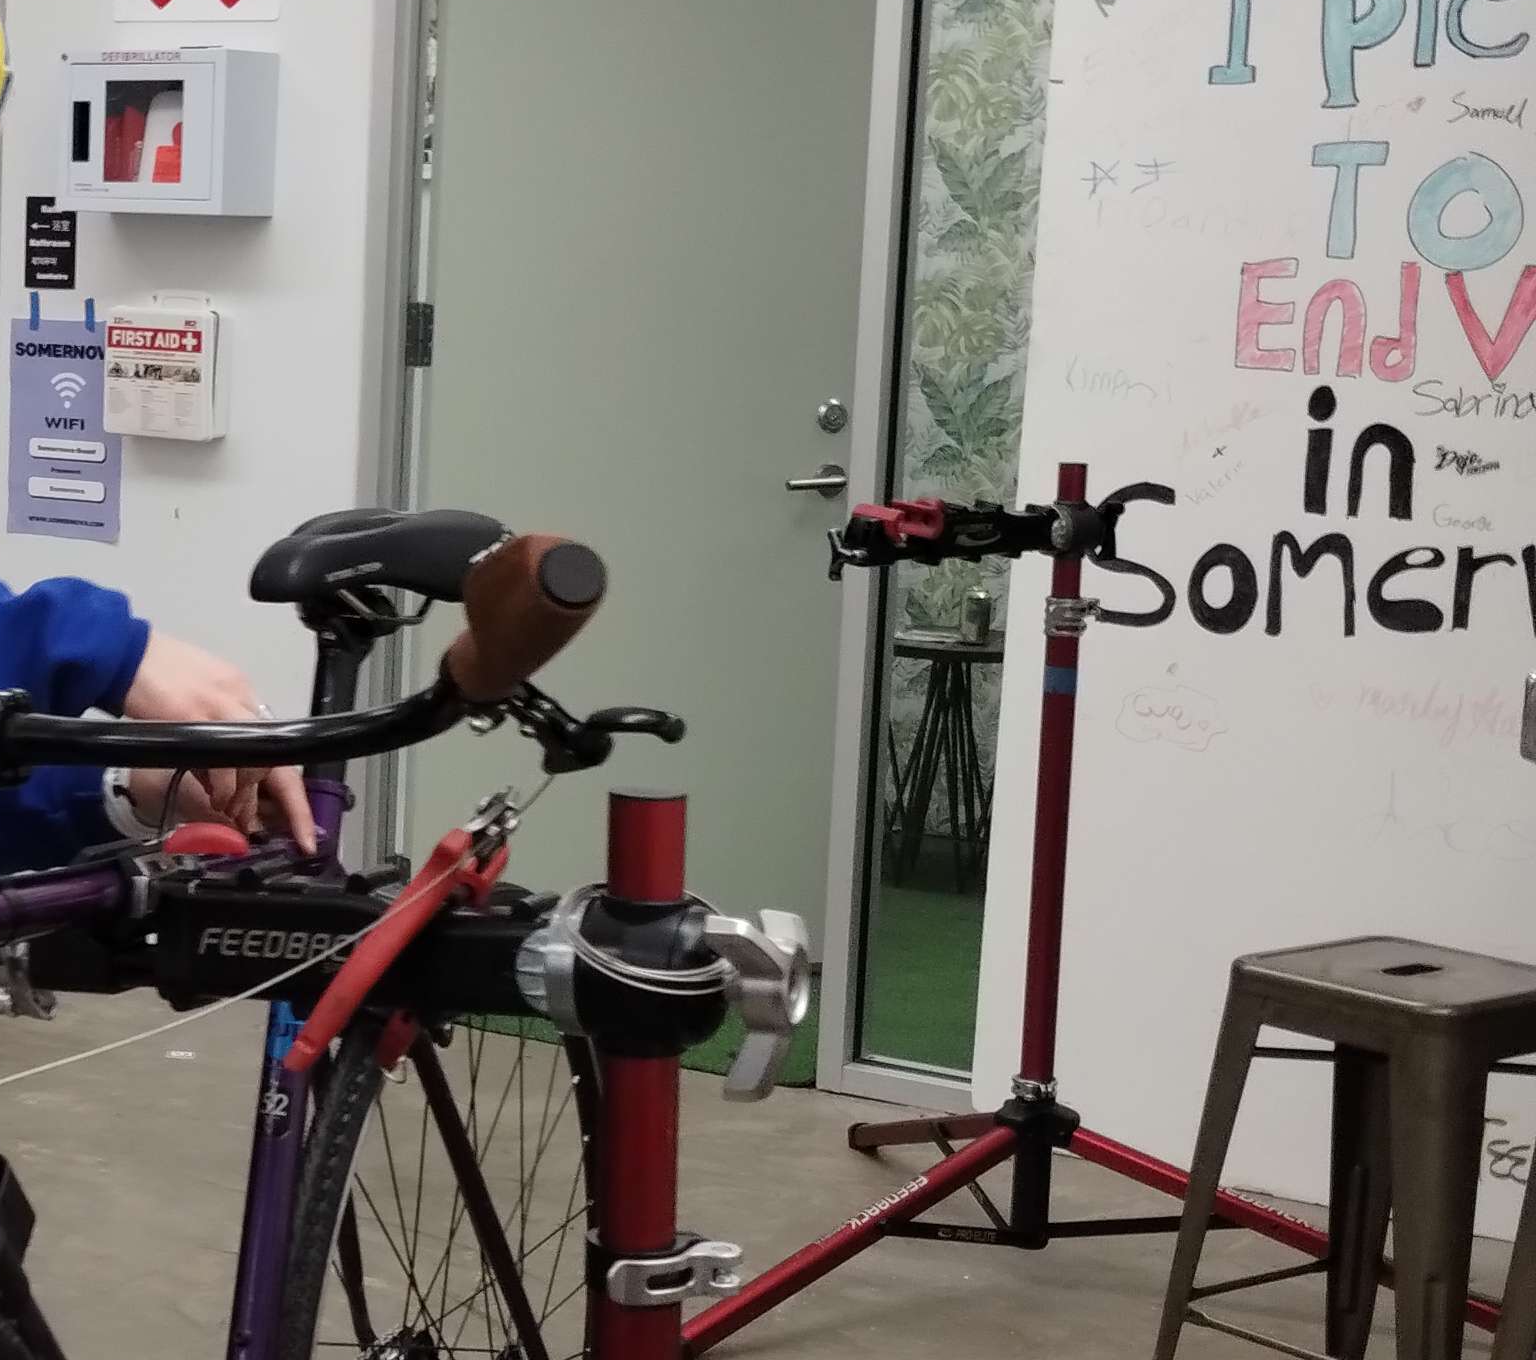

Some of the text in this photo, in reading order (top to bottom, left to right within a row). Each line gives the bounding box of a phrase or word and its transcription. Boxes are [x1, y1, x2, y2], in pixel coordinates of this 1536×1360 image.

[1312, 140, 1525, 272] TO
[111, 329, 181, 348] FIRST AID
[1235, 257, 1421, 383] End
[45, 416, 85, 431] WIFI
[1305, 385, 1416, 520] in
